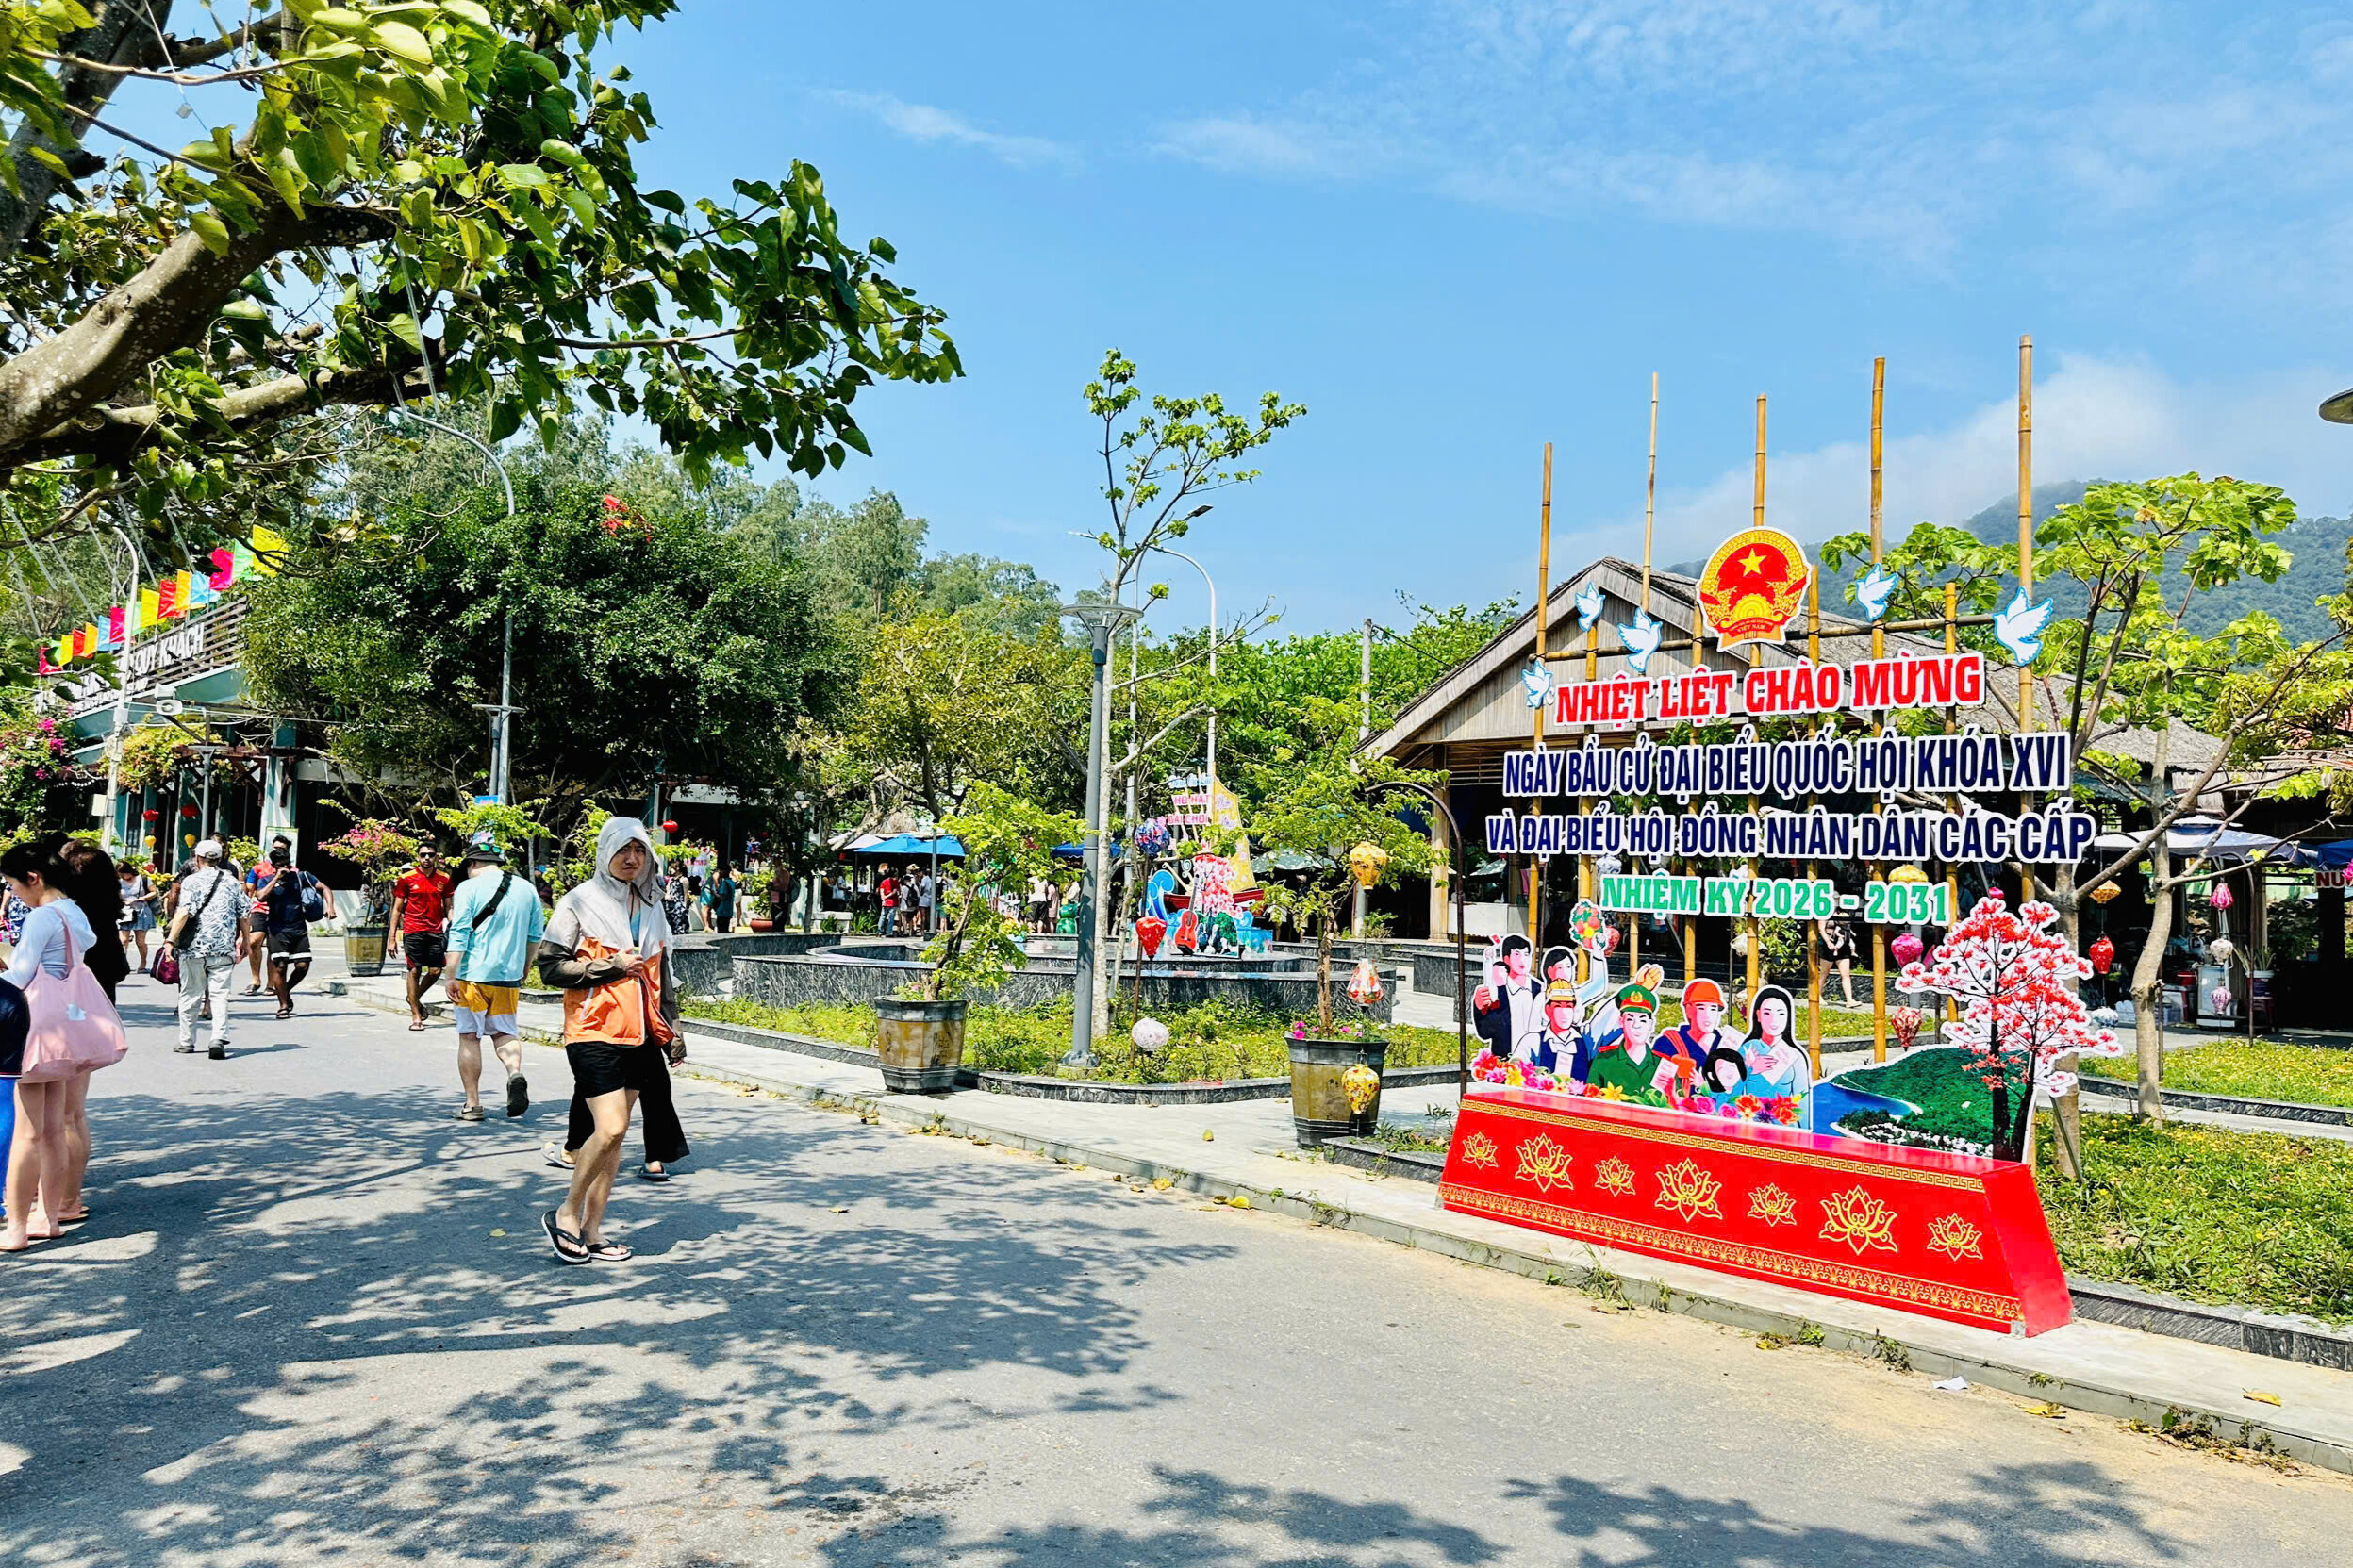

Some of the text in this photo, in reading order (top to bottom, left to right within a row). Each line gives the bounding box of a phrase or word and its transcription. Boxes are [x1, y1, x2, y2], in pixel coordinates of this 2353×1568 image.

[1556, 652, 1980, 727] NHIỆT LIỆT CHÀO MỪNG
[1506, 727, 2065, 801] NGÀY BẦU CỬ ĐẠI BIỂU QUỐC HỘI KHÓA XVI
[1488, 801, 2092, 861] VÀ ĐẠI BIỂU HỘI ĐỒNG NHÂN DÂN CÁC CẤP
[1602, 870, 1698, 916] NHIỆM
[1706, 874, 1747, 914] KỲ
[1754, 882, 1831, 917] 2026
[1868, 884, 1947, 922] 2031
